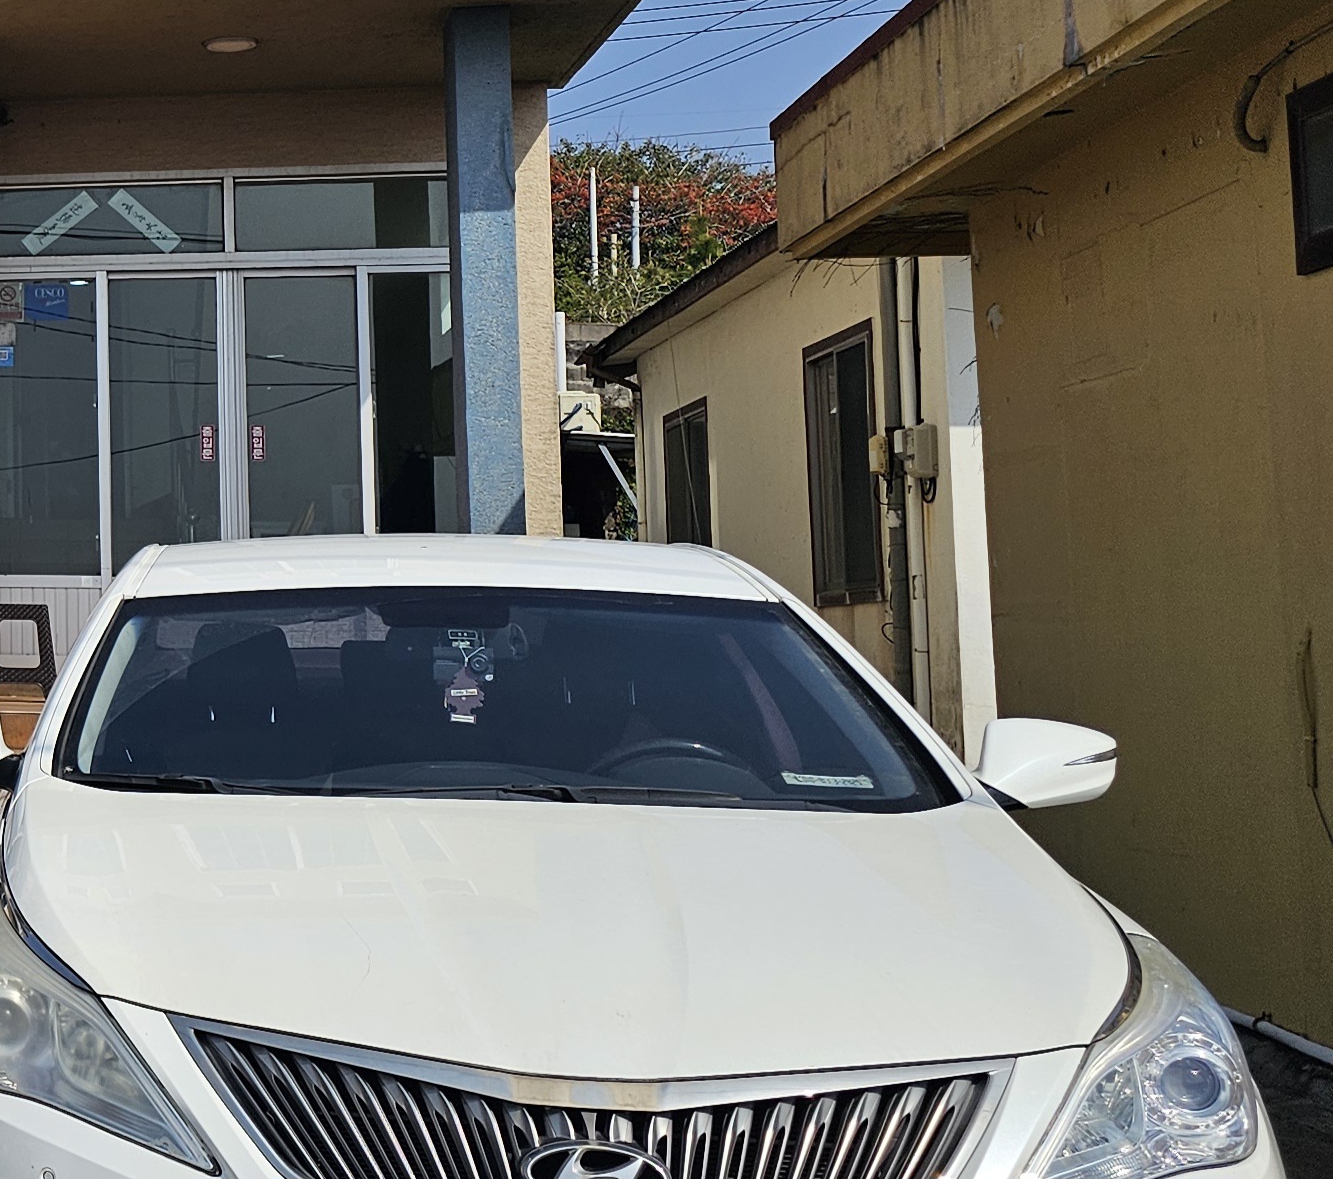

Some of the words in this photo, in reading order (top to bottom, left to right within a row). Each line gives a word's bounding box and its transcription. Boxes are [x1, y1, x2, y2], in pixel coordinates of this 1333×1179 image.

[34, 287, 65, 298] CESCO
[202, 426, 213, 460] 출입문
[252, 426, 264, 460] 출입문
